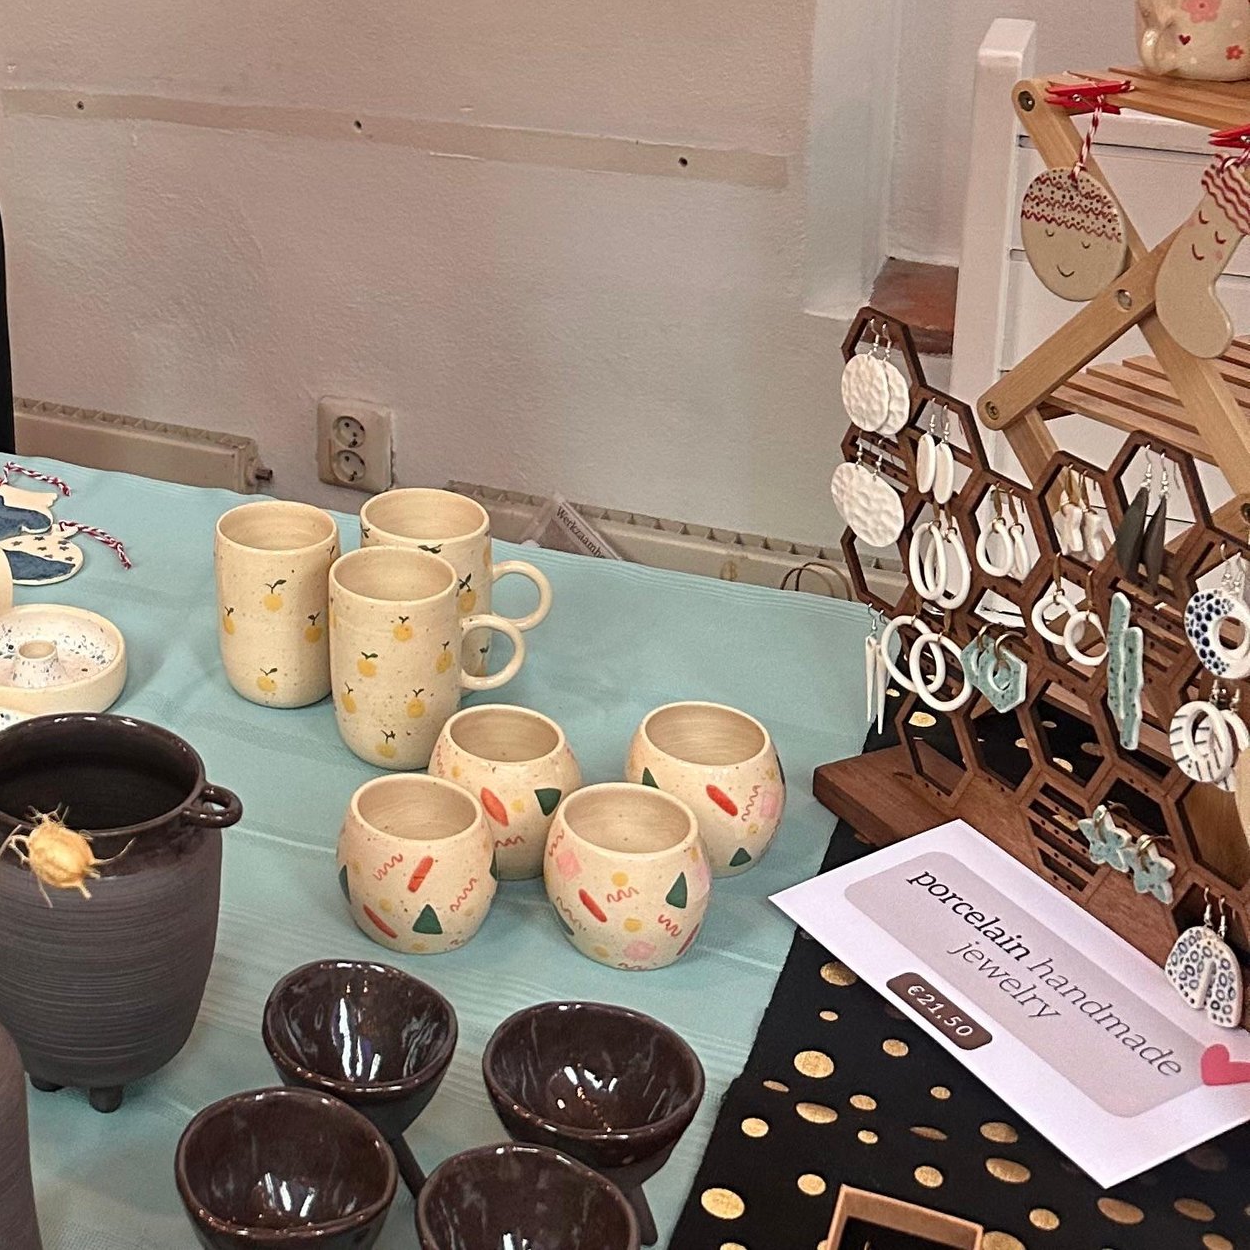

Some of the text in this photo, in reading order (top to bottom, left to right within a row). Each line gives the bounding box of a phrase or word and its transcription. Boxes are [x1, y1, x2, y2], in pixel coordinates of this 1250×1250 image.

[905, 870, 1183, 1077] porcelain handmade
[906, 984, 974, 1037] €21,50
[946, 940, 1062, 1018] jewelry
